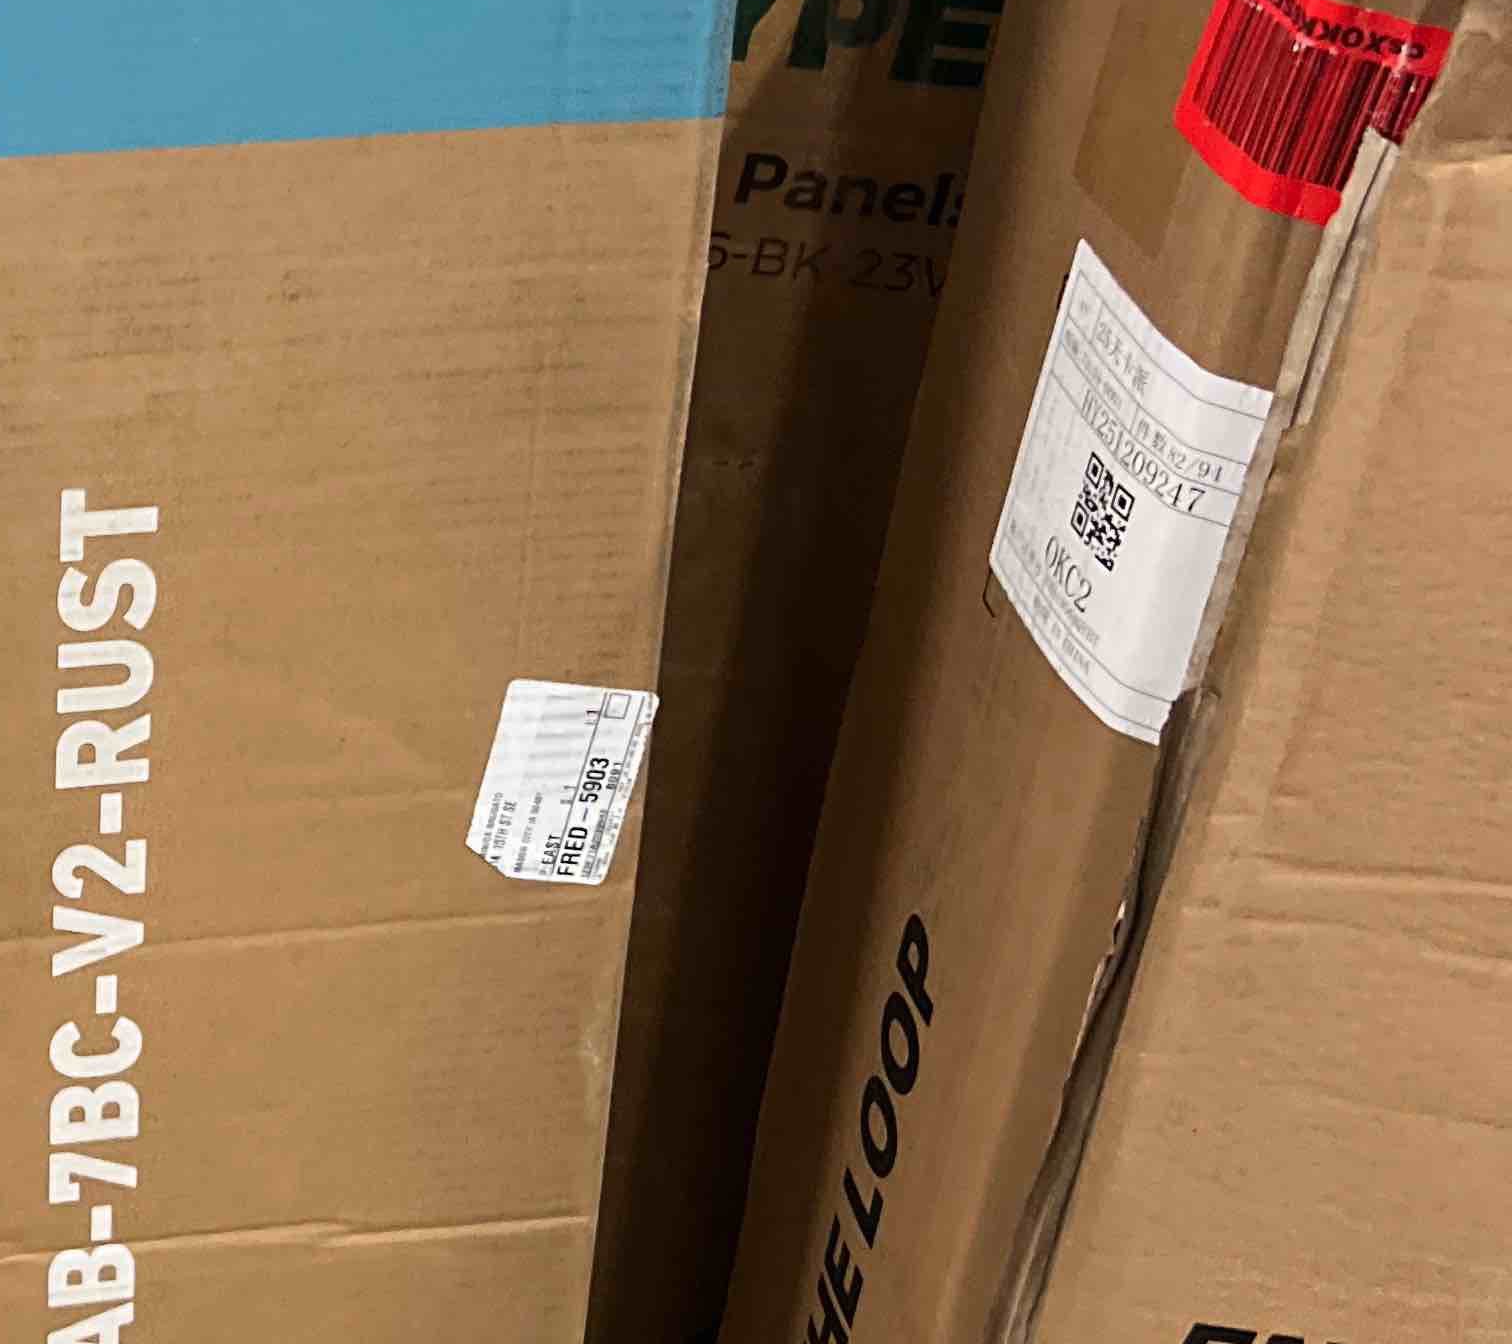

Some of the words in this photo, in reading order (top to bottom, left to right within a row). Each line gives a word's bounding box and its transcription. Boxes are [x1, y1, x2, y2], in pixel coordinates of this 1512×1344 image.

[557, 825, 588, 877] FRED
[579, 756, 610, 804] 5903
[842, 913, 934, 1250] LOOP
